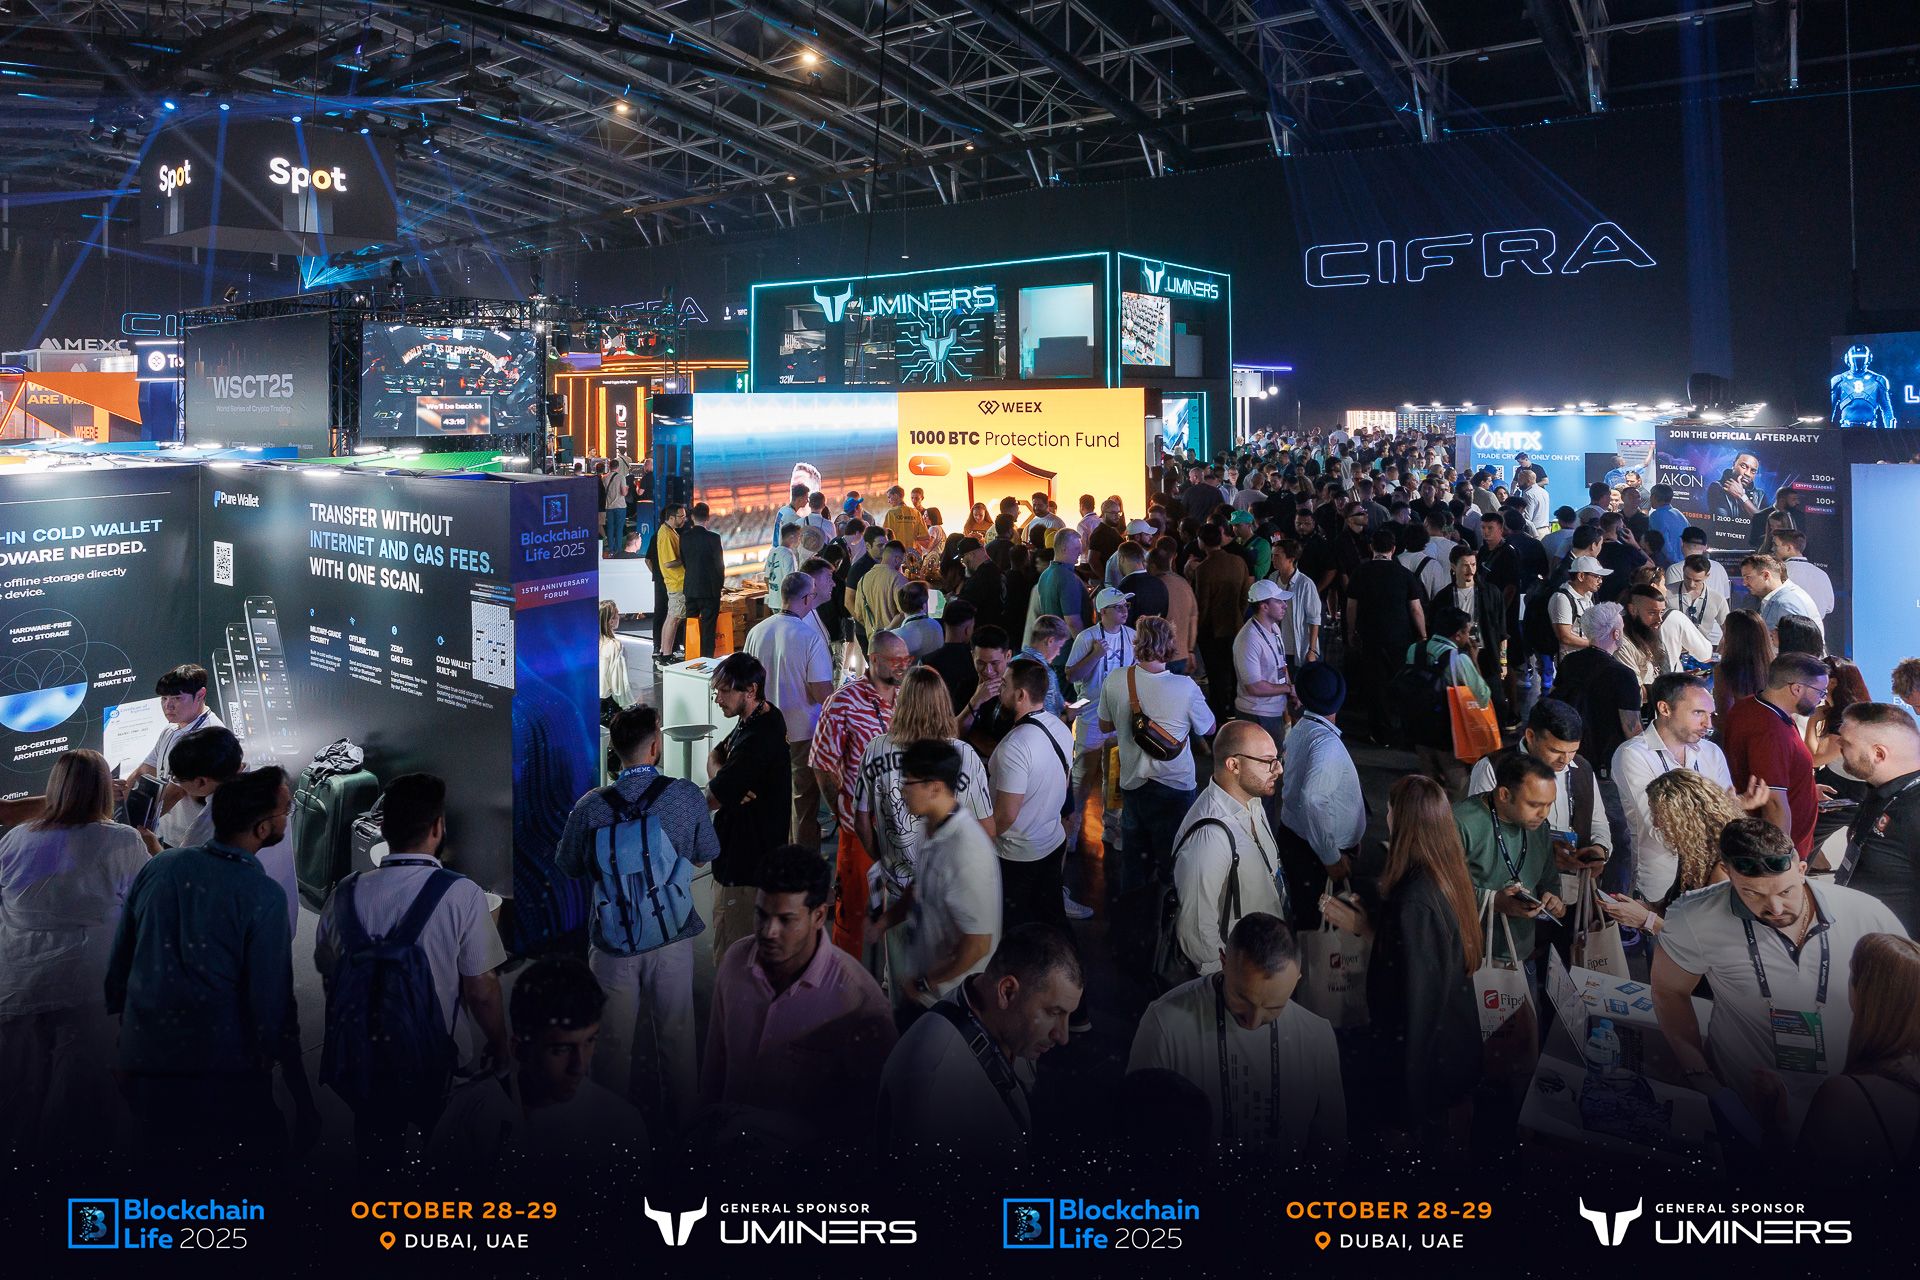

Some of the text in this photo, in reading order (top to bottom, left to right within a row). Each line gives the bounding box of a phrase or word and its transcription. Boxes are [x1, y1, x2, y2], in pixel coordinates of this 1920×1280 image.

[159, 160, 191, 197] Spot
[268, 157, 347, 194] Spot
[1305, 222, 1657, 288] CIFRA
[1167, 276, 1218, 299] UMINERS
[858, 285, 996, 316] UMINERS
[64, 338, 129, 351] MEXC
[211, 374, 294, 399] WSCT25
[28, 394, 59, 405] ARE
[1002, 401, 1042, 413] WEEX
[74, 425, 99, 439] WHERE
[910, 430, 1120, 448] 1000 BTC Protection Fund
[1669, 430, 1819, 443] JOIN THE OFFICIAL AFTERPARTY
[1493, 431, 1542, 450] HTX
[1477, 452, 1500, 461] TRADE
[1565, 454, 1580, 462] HTX
[1659, 472, 1703, 488] AKON
[1811, 474, 1835, 482] 1300+
[220, 491, 259, 507] Pure Wallet
[310, 503, 453, 537] TRANSFER WITHOUT
[32, 525, 85, 543] COLD
[91, 519, 163, 537] WALLET
[521, 527, 590, 546] Blockchain
[70, 540, 147, 560] NEEDED.
[310, 530, 494, 574] INTERNET AND GAS FEES.
[525, 542, 586, 562] Life 2025
[4, 567, 127, 588] offline storage directly
[309, 556, 424, 594] WITH ONE SCAN.
[5, 587, 46, 600] device.
[521, 585, 539, 595] 15TH
[540, 577, 590, 591] ANNIVERSARY
[544, 590, 569, 600] FORUM
[9, 620, 72, 635] HARDWARE-FREE
[12, 630, 70, 643] COLD STORAGE
[390, 644, 404, 654] ZERO
[436, 655, 472, 671] COLD WALLET
[98, 668, 132, 679] ISOLATED
[436, 665, 458, 678] BUILT-IN
[93, 675, 137, 689] PRIVATE KEY
[14, 736, 68, 752] ISO-CERTIFIED
[630, 766, 651, 774] MEXC
[2, 790, 29, 800] Offline
